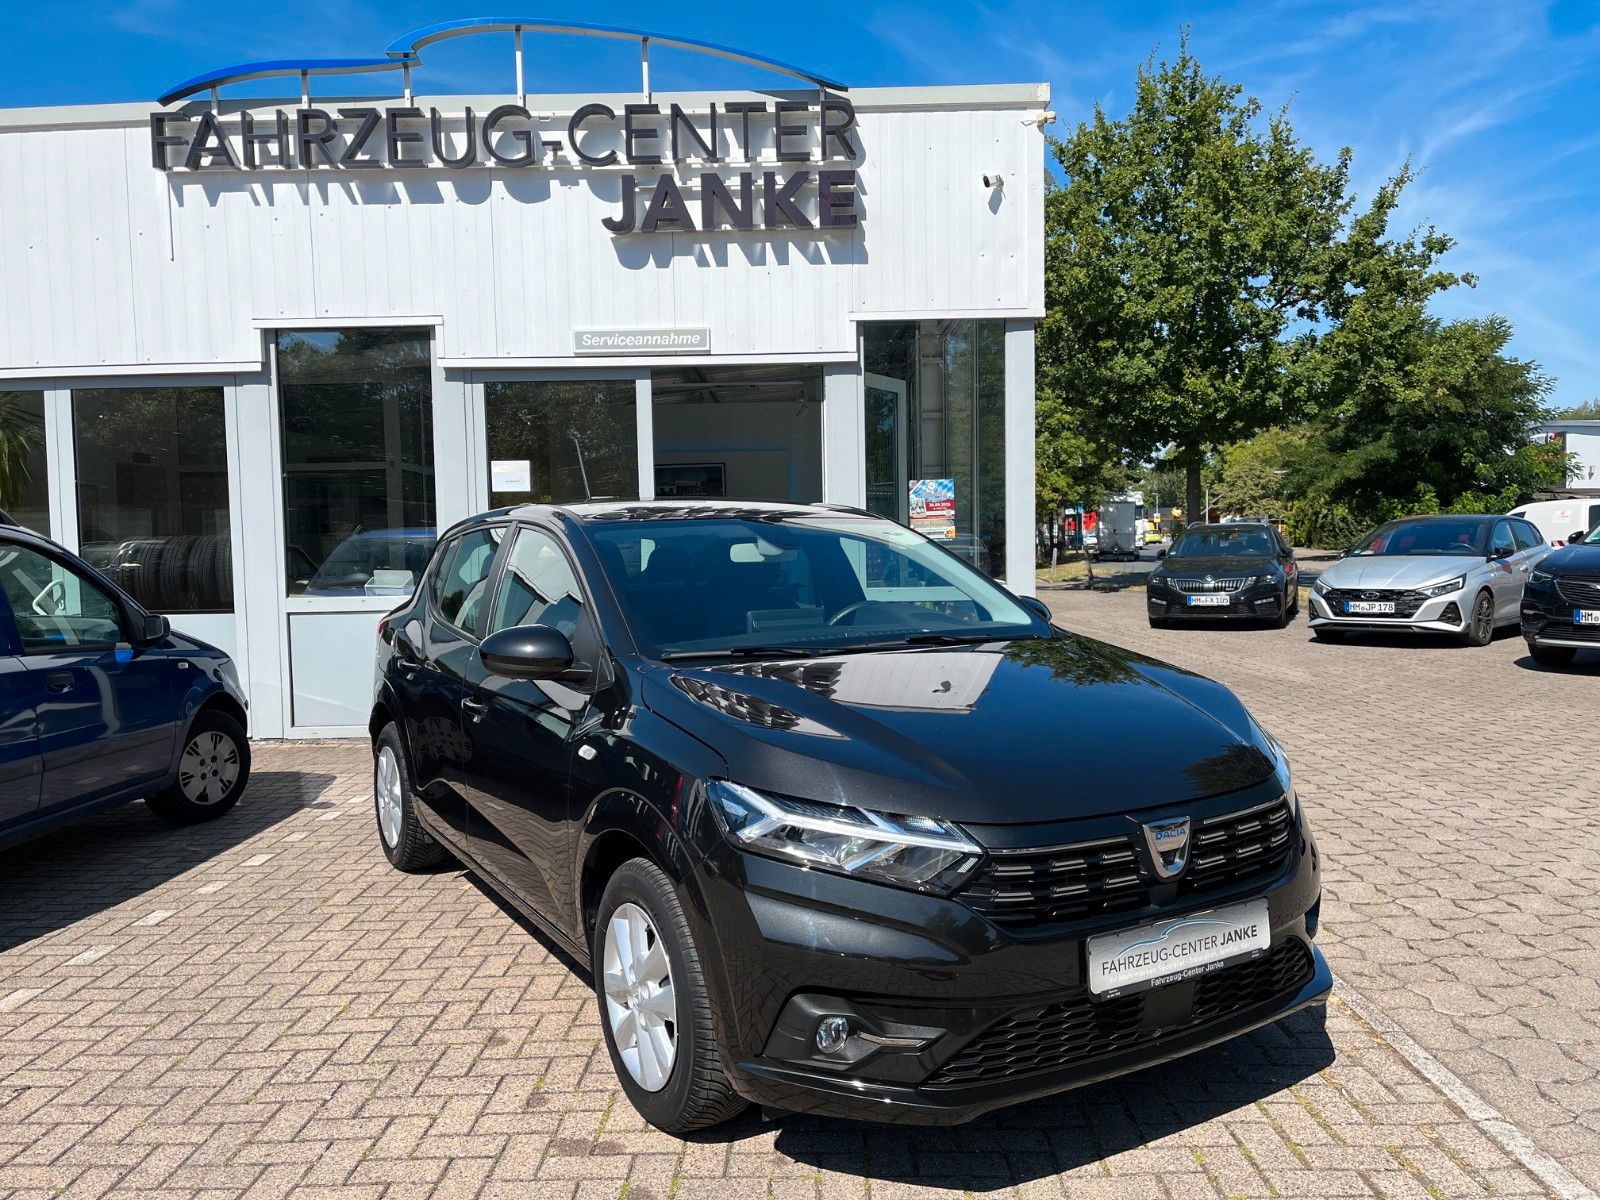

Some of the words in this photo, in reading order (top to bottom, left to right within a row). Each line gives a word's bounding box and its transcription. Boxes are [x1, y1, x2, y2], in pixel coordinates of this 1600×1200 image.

[150, 100, 857, 172] FAHRZEUG-CENTER
[601, 170, 858, 235] JANKE
[581, 332, 701, 346] Serviceannahme
[1581, 611, 1593, 622] HM
[1155, 828, 1186, 840] DACIA
[1102, 935, 1218, 976] FAHRZEUG-CENTER
[1220, 925, 1258, 946] JANKE
[1150, 965, 1205, 987] Fahrzeug-Center
[1205, 960, 1225, 972] Janke
